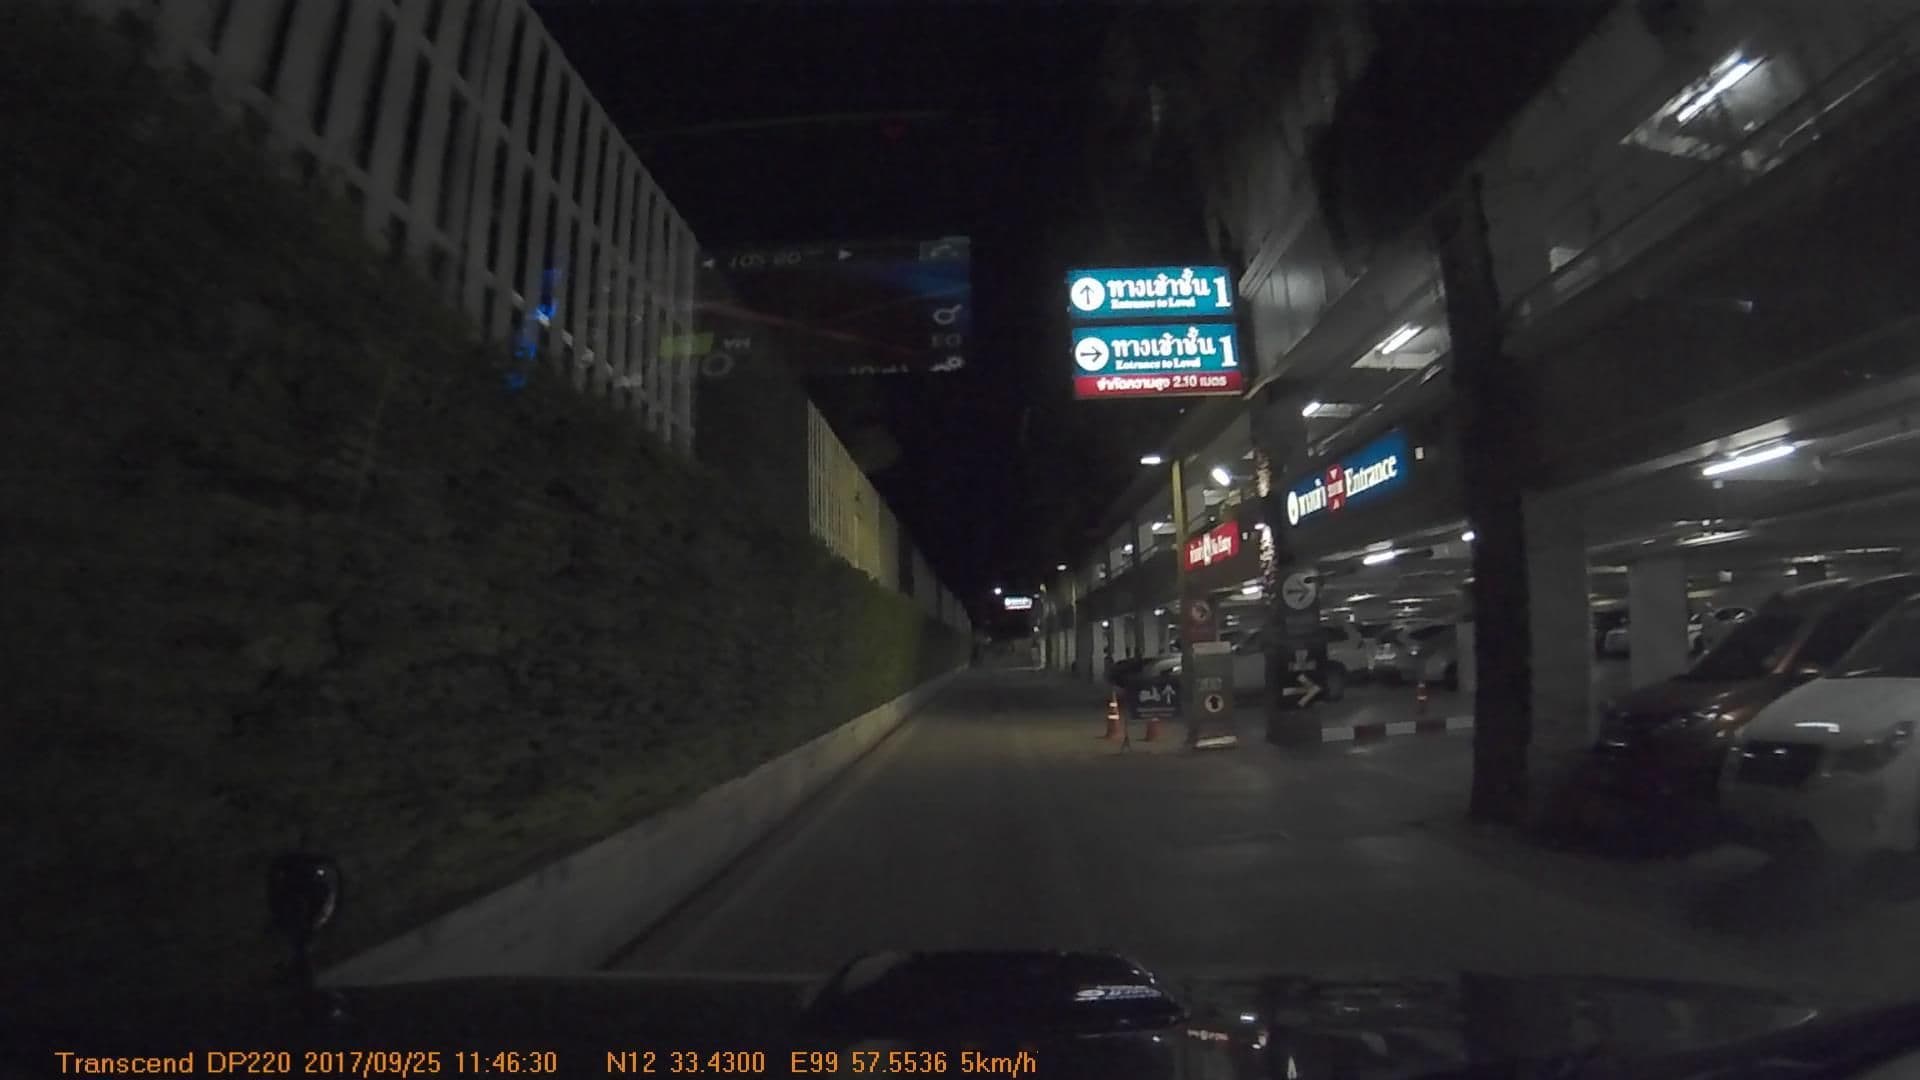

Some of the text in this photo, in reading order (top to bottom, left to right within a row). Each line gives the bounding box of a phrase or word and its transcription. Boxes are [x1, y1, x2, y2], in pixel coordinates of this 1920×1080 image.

[1106, 267, 1231, 307] ทางเข้าชั้น 1
[1110, 297, 1196, 310] Entrance to Level
[1111, 326, 1237, 367] ทางเข้าชั้น 1
[1115, 357, 1201, 371] Entrance to Level
[1173, 375, 1197, 388] 2.10
[1200, 375, 1227, 387] เมตร
[1343, 455, 1398, 498] Entrance
